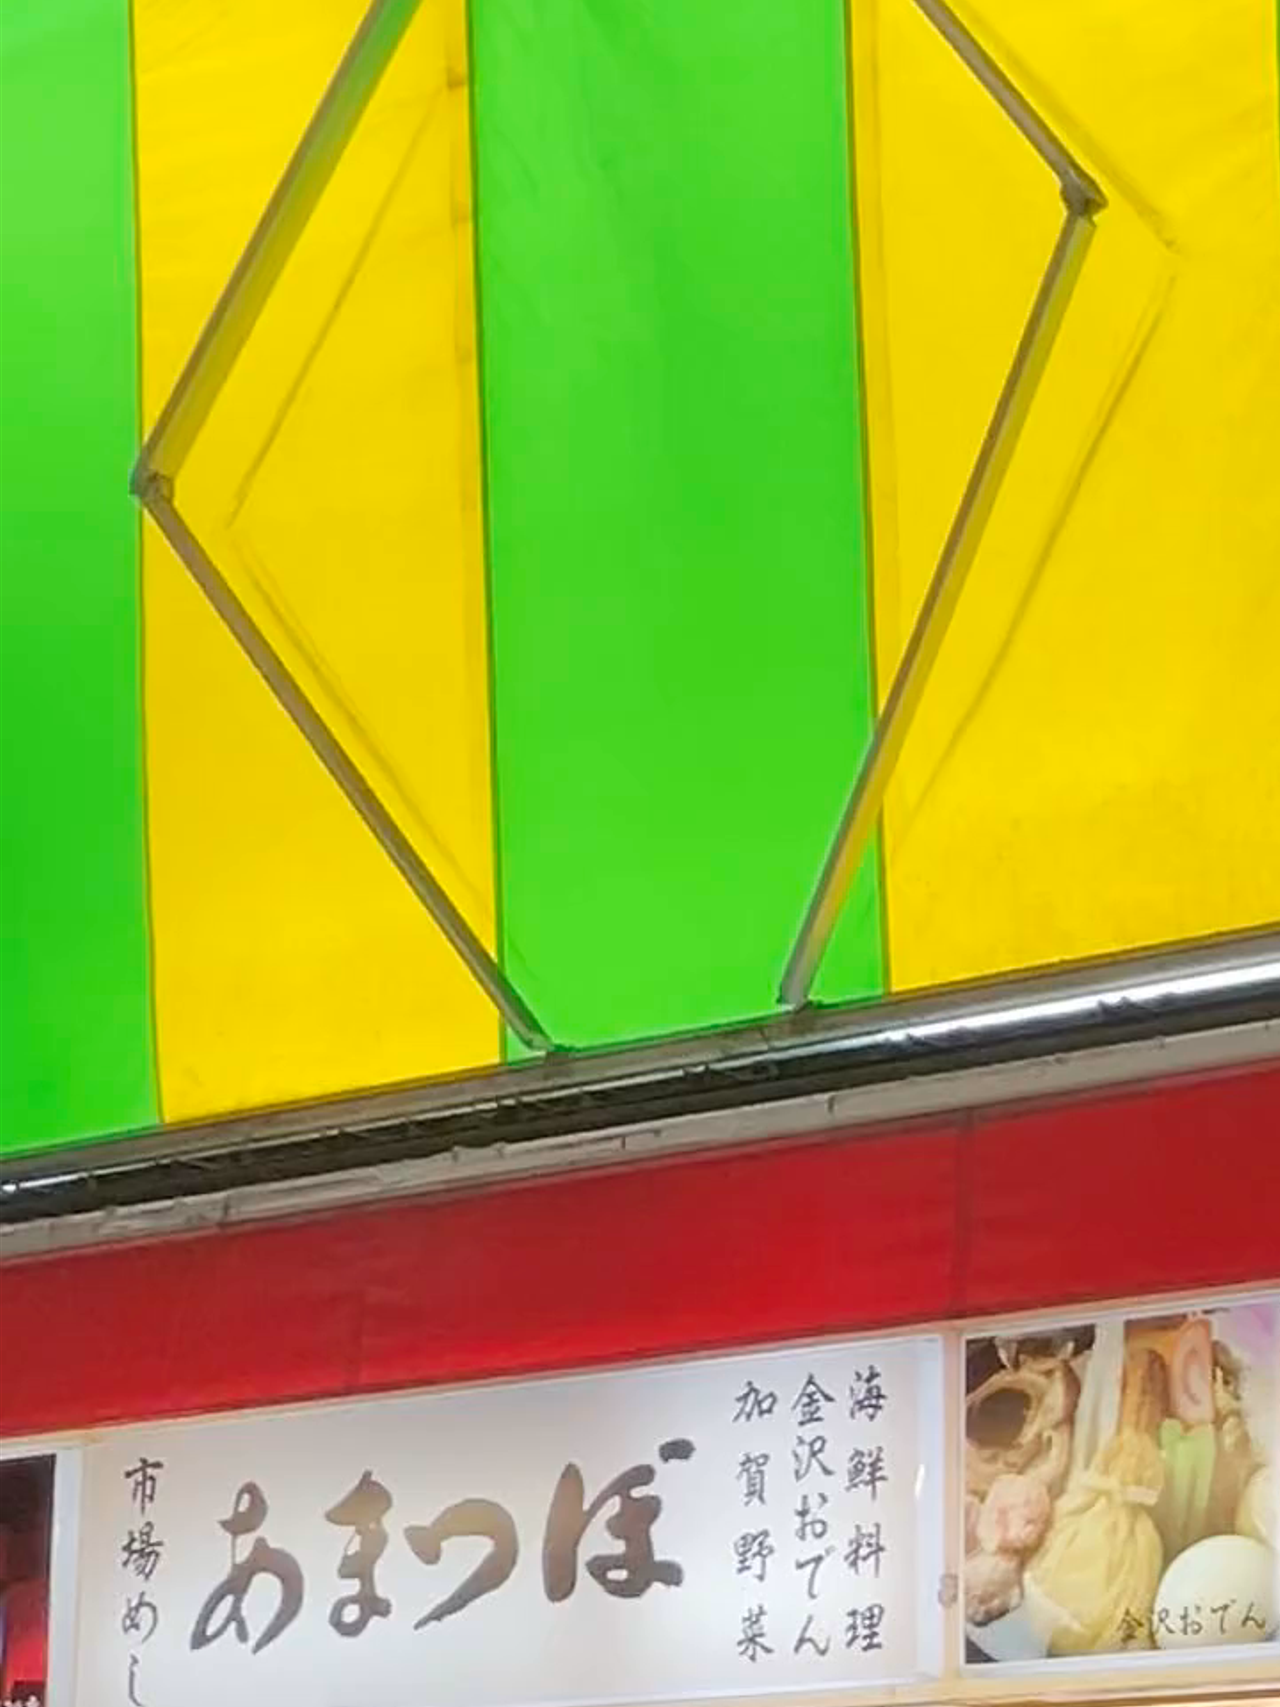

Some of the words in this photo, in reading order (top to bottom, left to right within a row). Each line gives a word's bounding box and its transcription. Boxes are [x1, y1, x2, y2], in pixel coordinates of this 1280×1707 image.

[121, 1457, 164, 1707] 市場めし
[190, 1438, 695, 1654] あまつぼ
[733, 1381, 777, 1662] 加賀野菜
[792, 1373, 836, 1657] 金沢おでん
[844, 1365, 888, 1652] 海鮮料理
[1116, 1598, 1266, 1646] 金沢おでん
